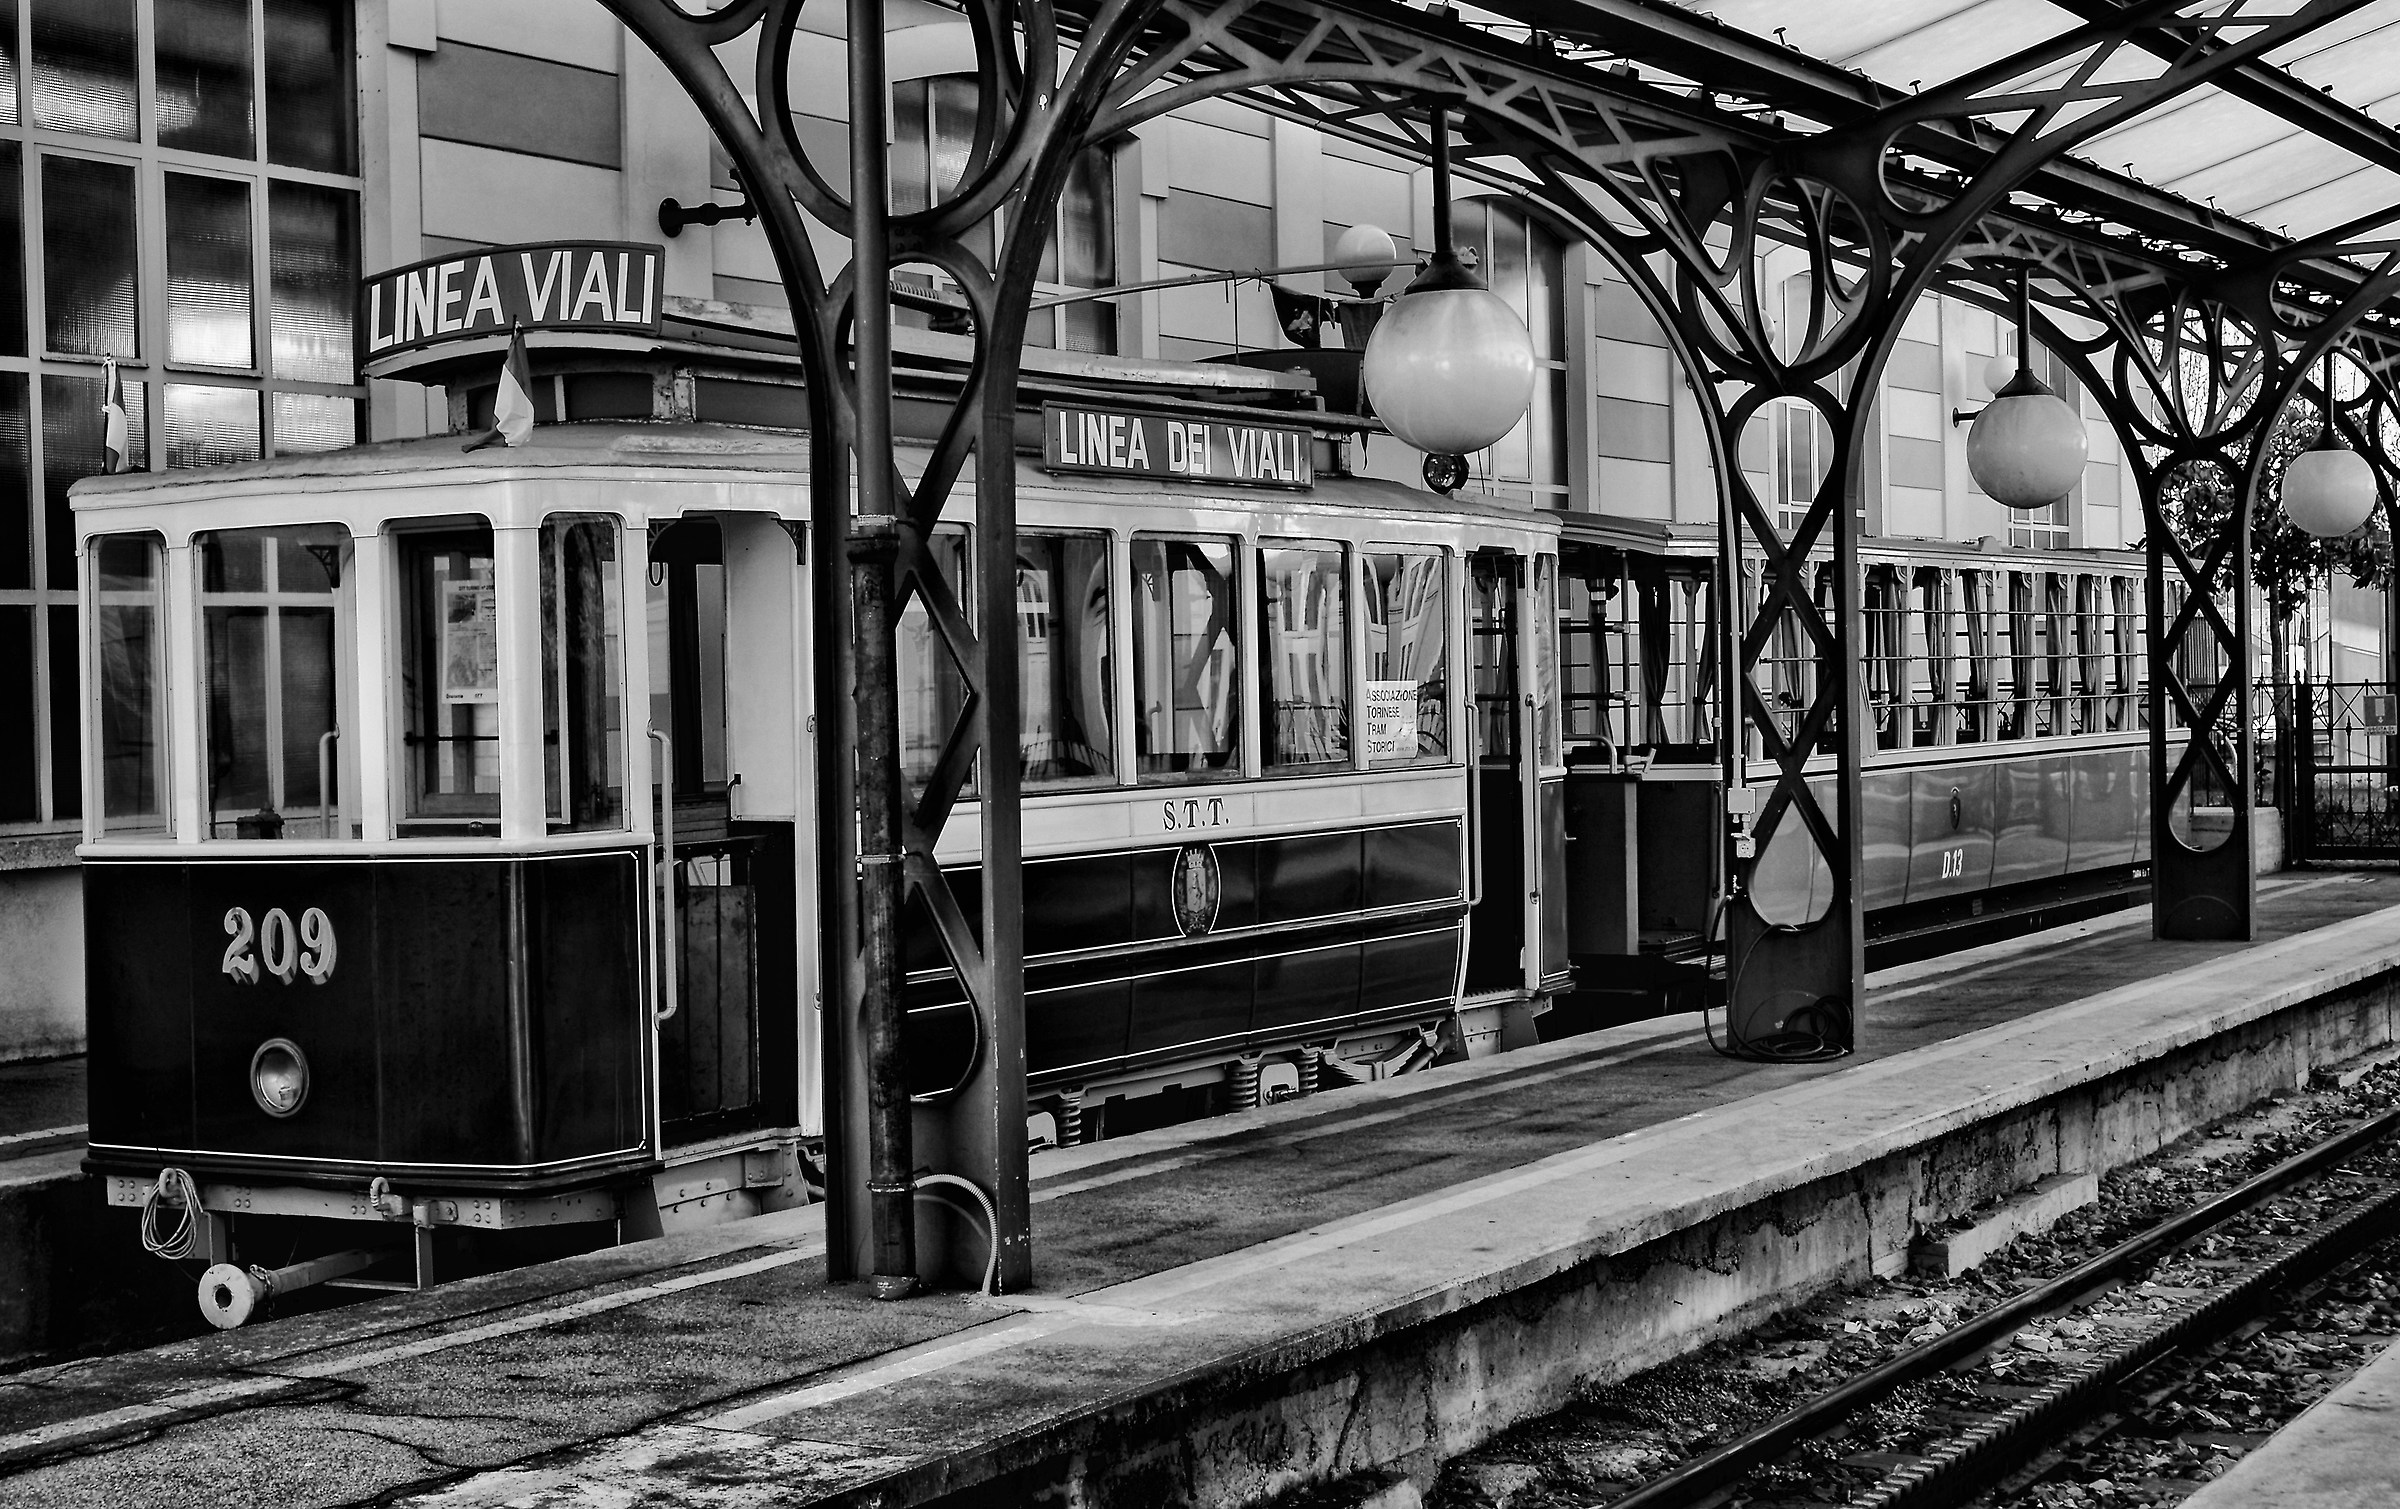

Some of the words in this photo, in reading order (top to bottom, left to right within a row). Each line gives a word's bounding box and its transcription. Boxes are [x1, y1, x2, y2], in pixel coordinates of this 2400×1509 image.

[370, 256, 505, 353] LINEA
[520, 251, 655, 324] VIALI
[1059, 409, 1150, 470] LINEA
[1166, 421, 1211, 475] DEI
[1227, 427, 1300, 482] VIALI
[1366, 705, 1400, 718] TORINESE
[1367, 722, 1387, 736] TRAM
[1367, 739, 1395, 753] STORICI
[1162, 797, 1230, 831] S.T.T.
[1941, 848, 1963, 879] D.13
[222, 906, 337, 985] 209
